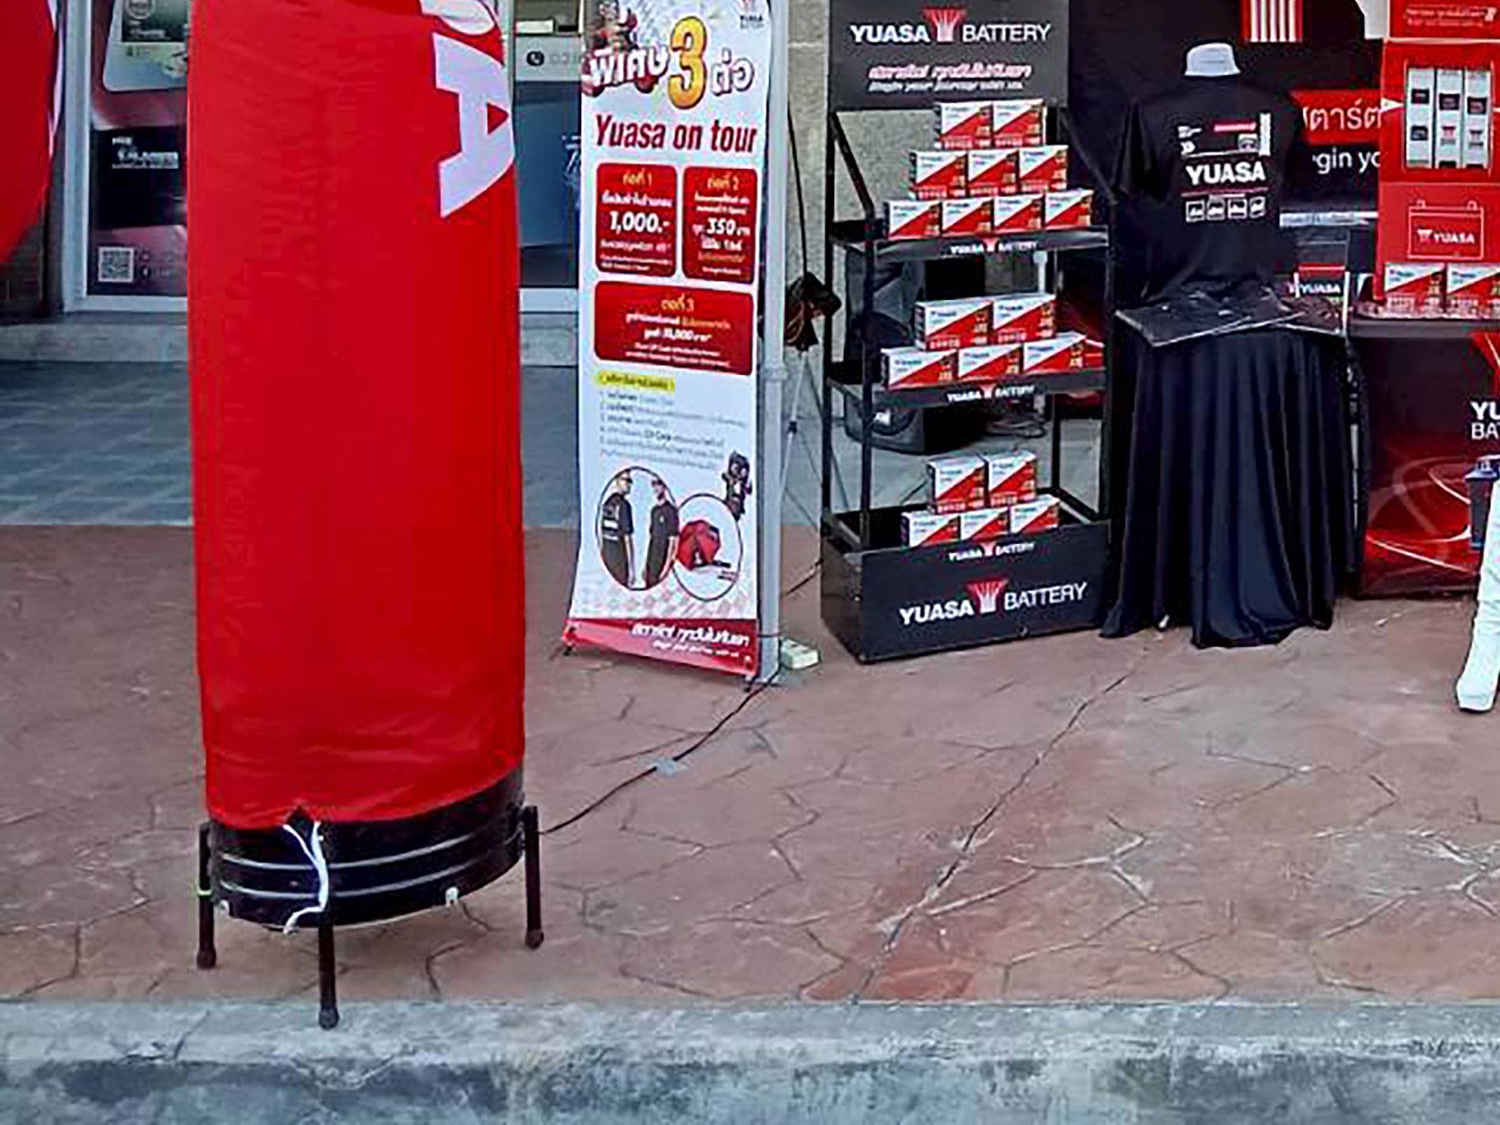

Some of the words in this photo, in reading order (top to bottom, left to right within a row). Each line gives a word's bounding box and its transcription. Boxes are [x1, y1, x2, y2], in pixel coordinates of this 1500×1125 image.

[850, 24, 930, 43] YUASA
[962, 24, 1051, 43] BATTERY
[667, 15, 708, 110] 3
[712, 48, 755, 97] ต่อ
[1303, 97, 1382, 131] ตาร์ต
[596, 114, 667, 148] Yuasa
[672, 123, 703, 150] on
[711, 119, 757, 153] tour
[1185, 160, 1267, 186] YUASA
[1312, 146, 1353, 175] gin
[609, 210, 671, 235] 1,000.-
[899, 599, 975, 626] YUASA
[1004, 581, 1088, 611] BATTERY
